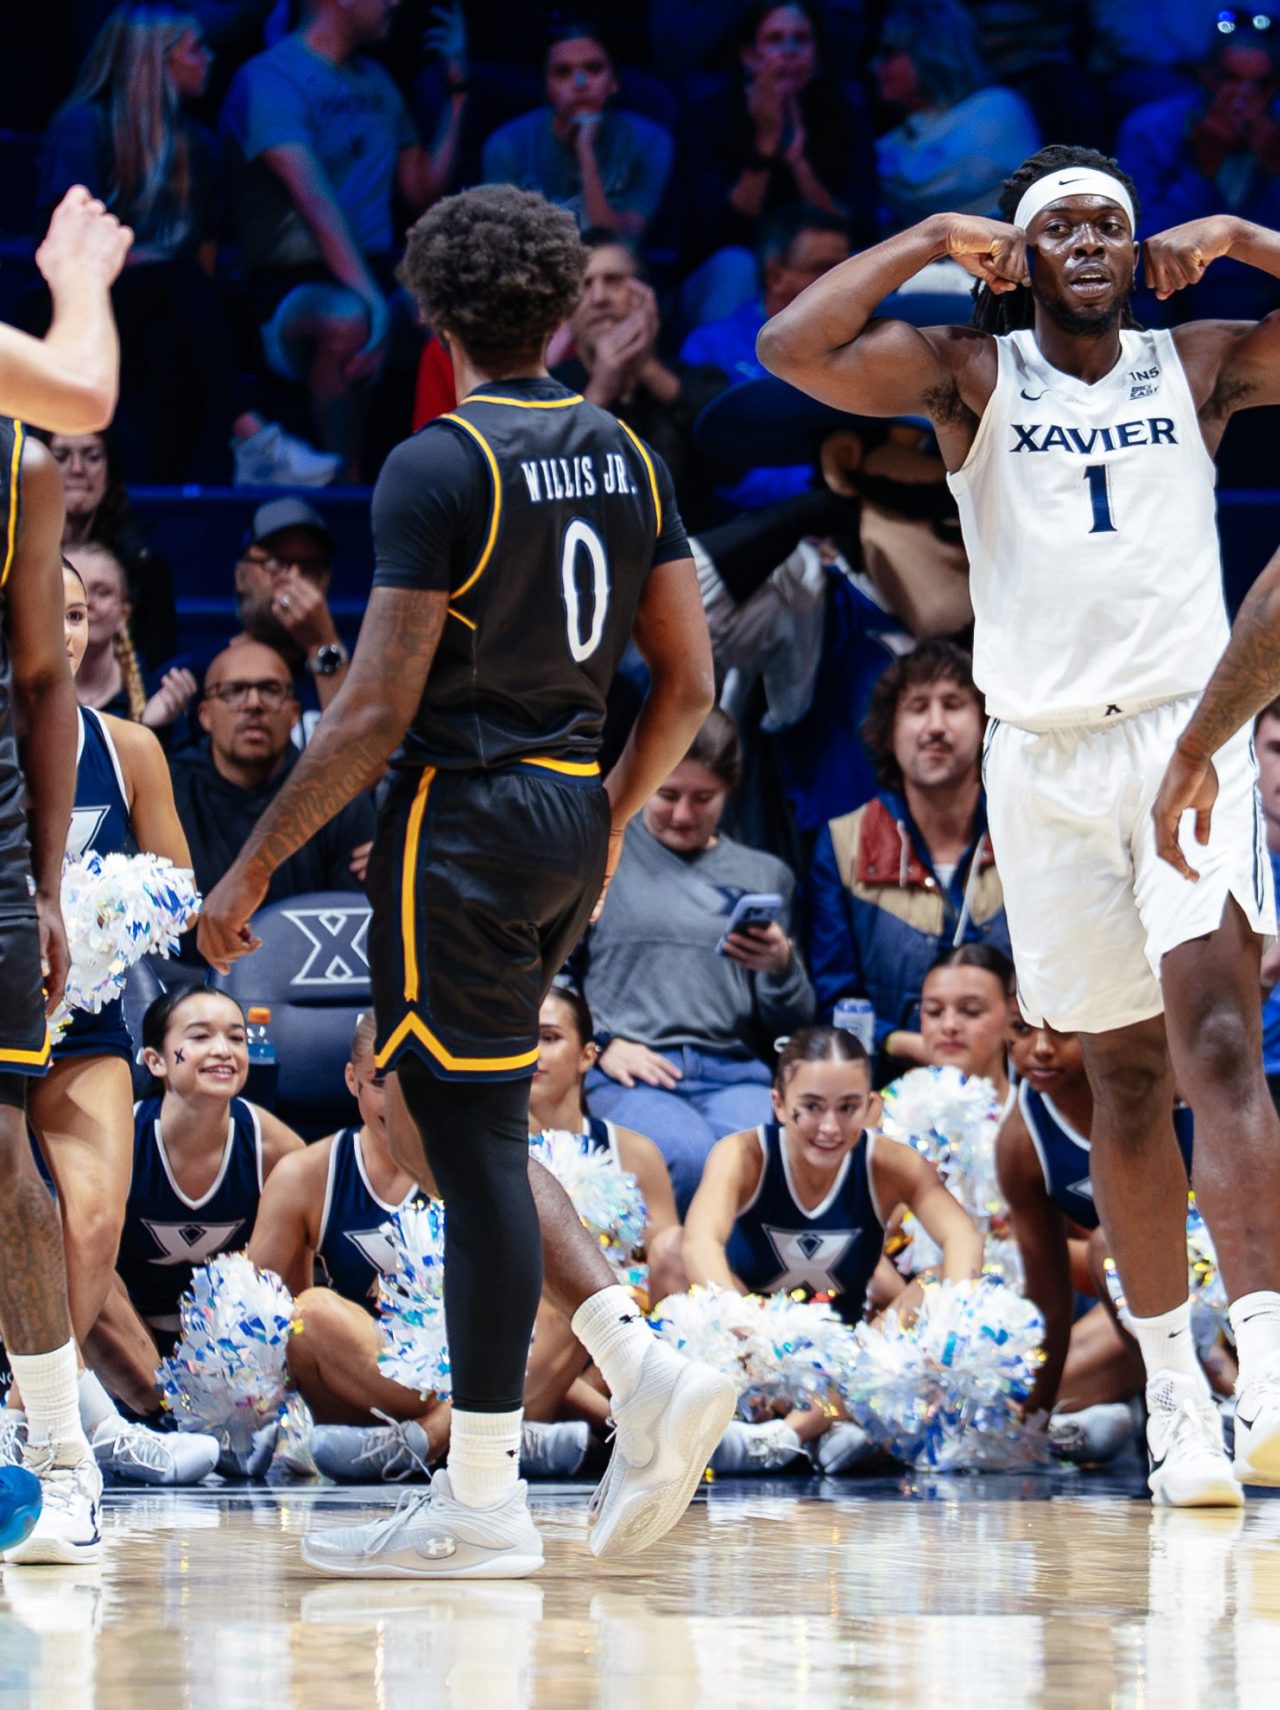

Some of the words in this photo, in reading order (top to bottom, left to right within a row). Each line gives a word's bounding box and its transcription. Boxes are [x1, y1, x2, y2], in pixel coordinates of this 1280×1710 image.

[1128, 366, 1160, 381] 1N5
[1009, 417, 1179, 455] XAVIER
[520, 455, 597, 502] WILLIS
[603, 453, 638, 494] JR.
[1083, 464, 1118, 533] 1
[562, 519, 611, 663] 0
